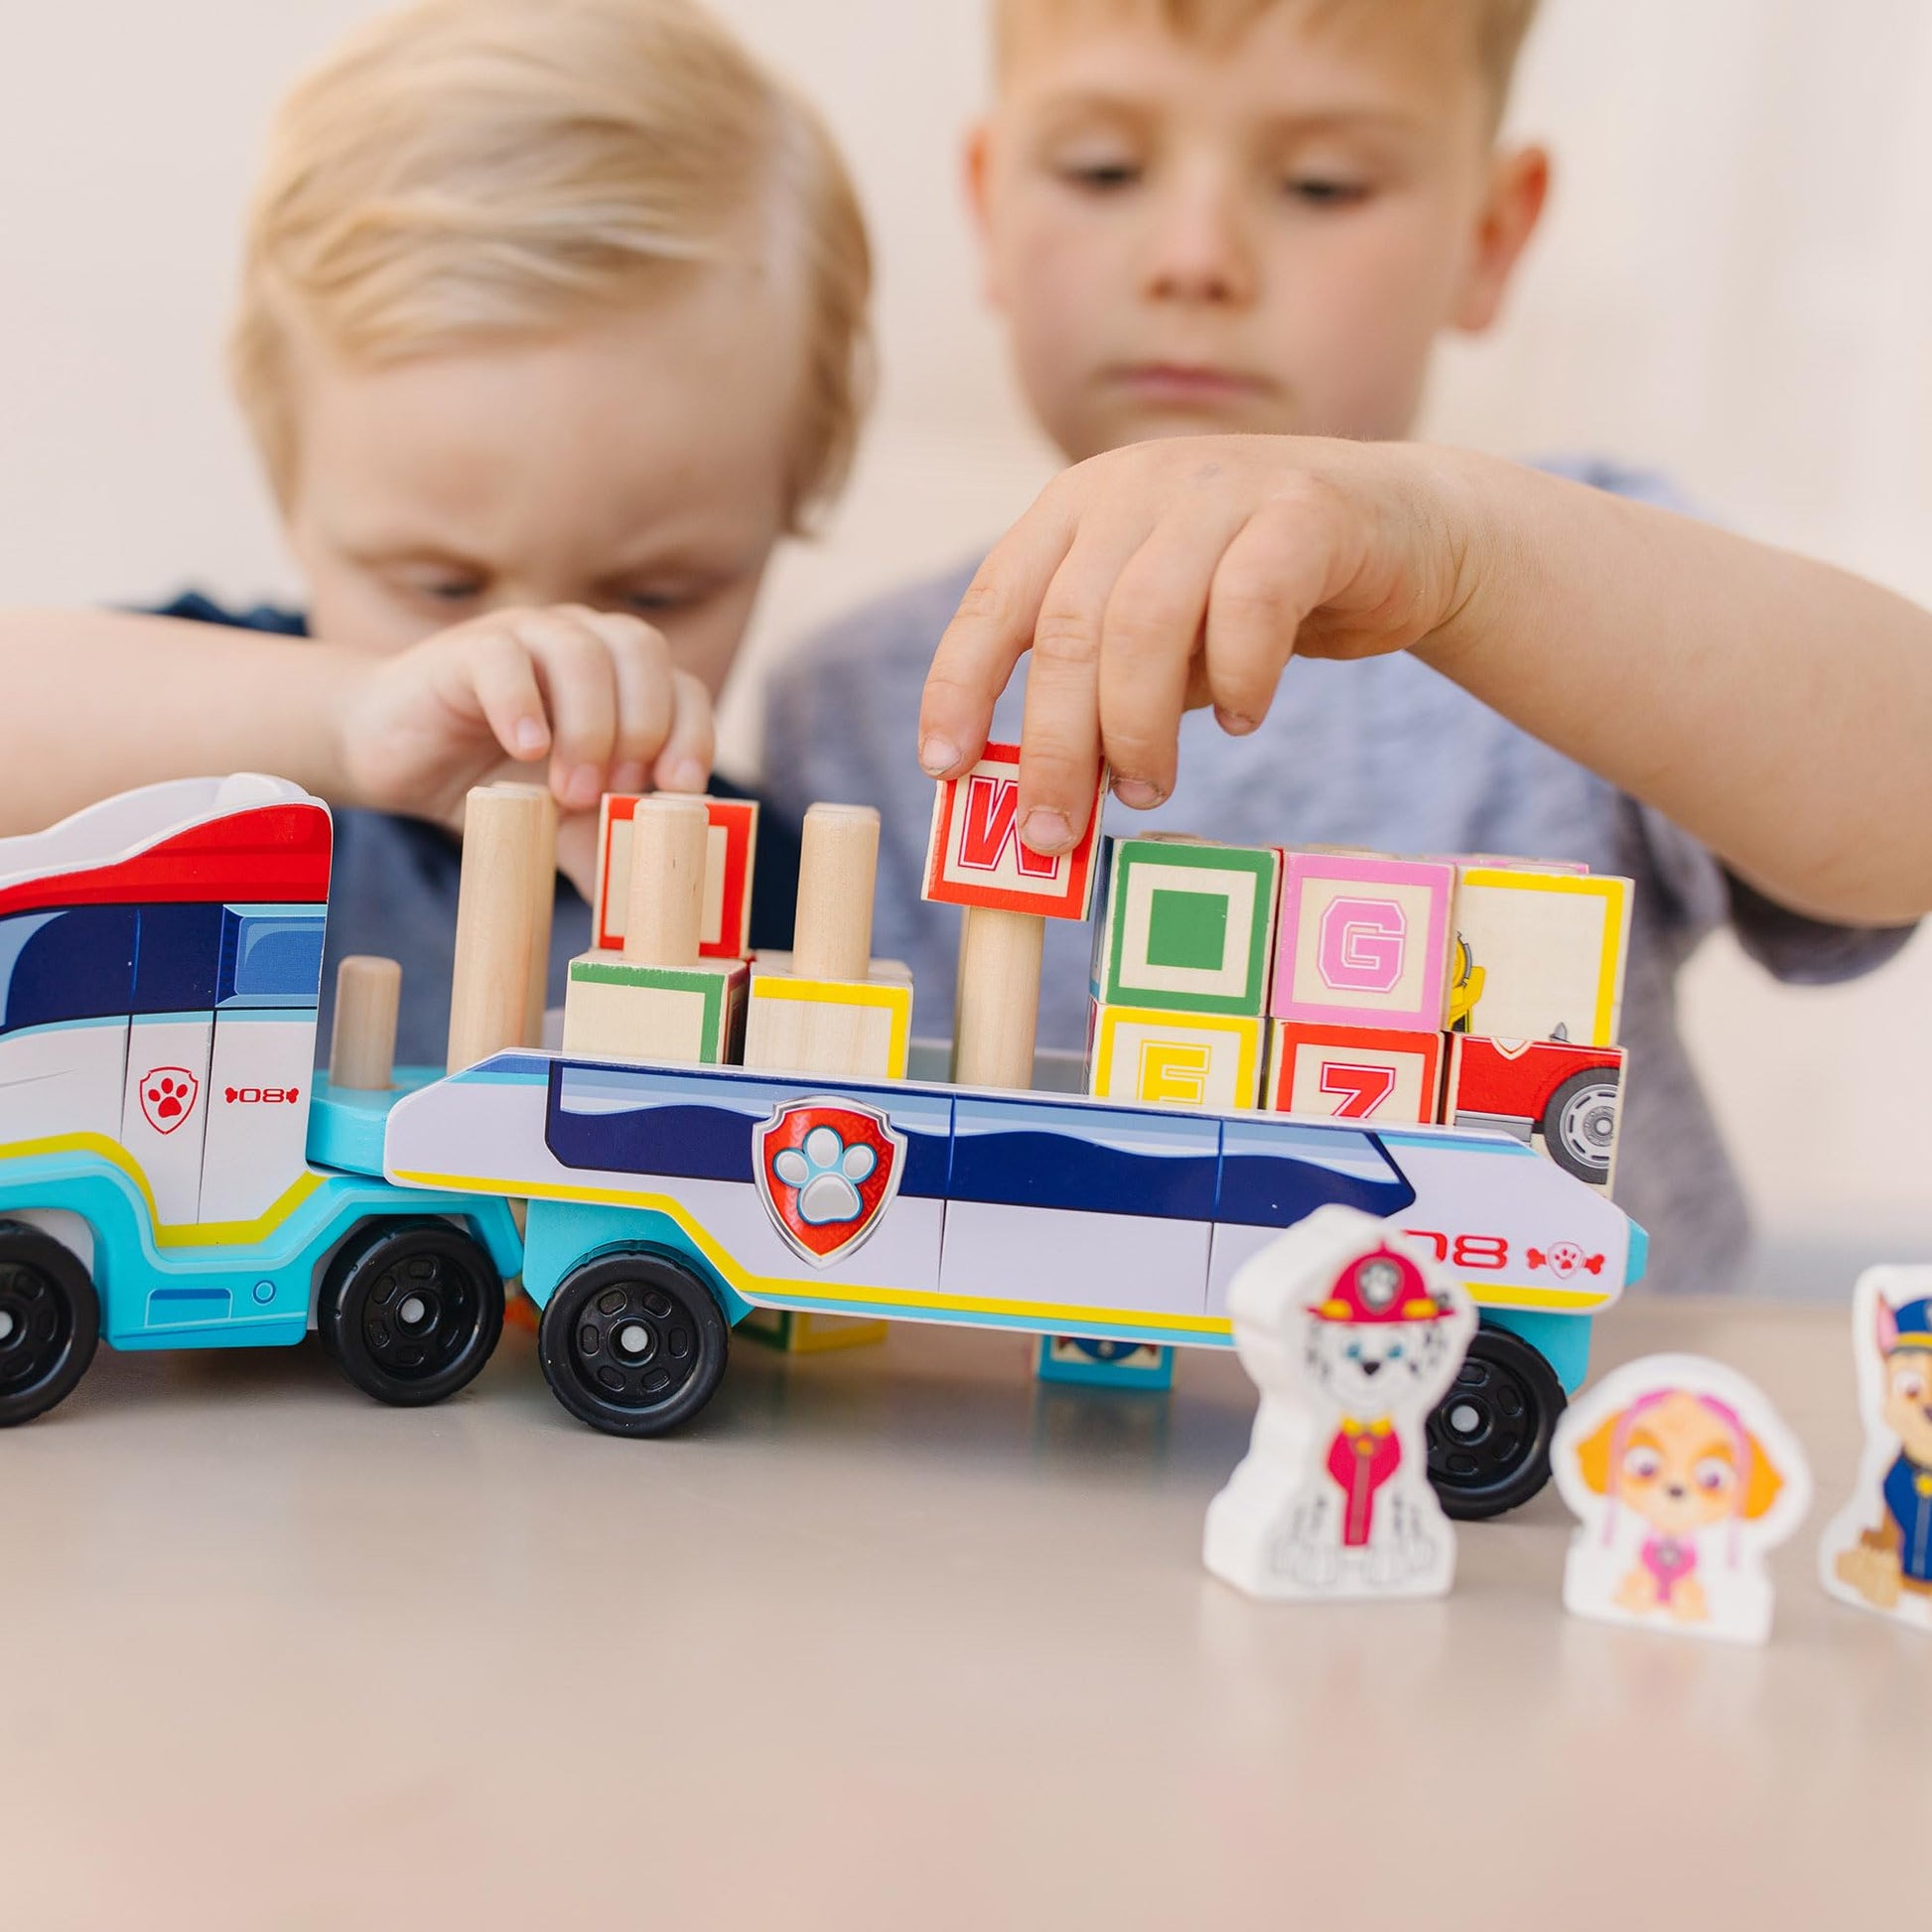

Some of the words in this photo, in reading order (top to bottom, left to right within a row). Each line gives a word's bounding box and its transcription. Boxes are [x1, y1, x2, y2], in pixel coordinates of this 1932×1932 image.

[958, 774, 1060, 881] W
[1317, 896, 1407, 994] G
[239, 1088, 285, 1103] 08
